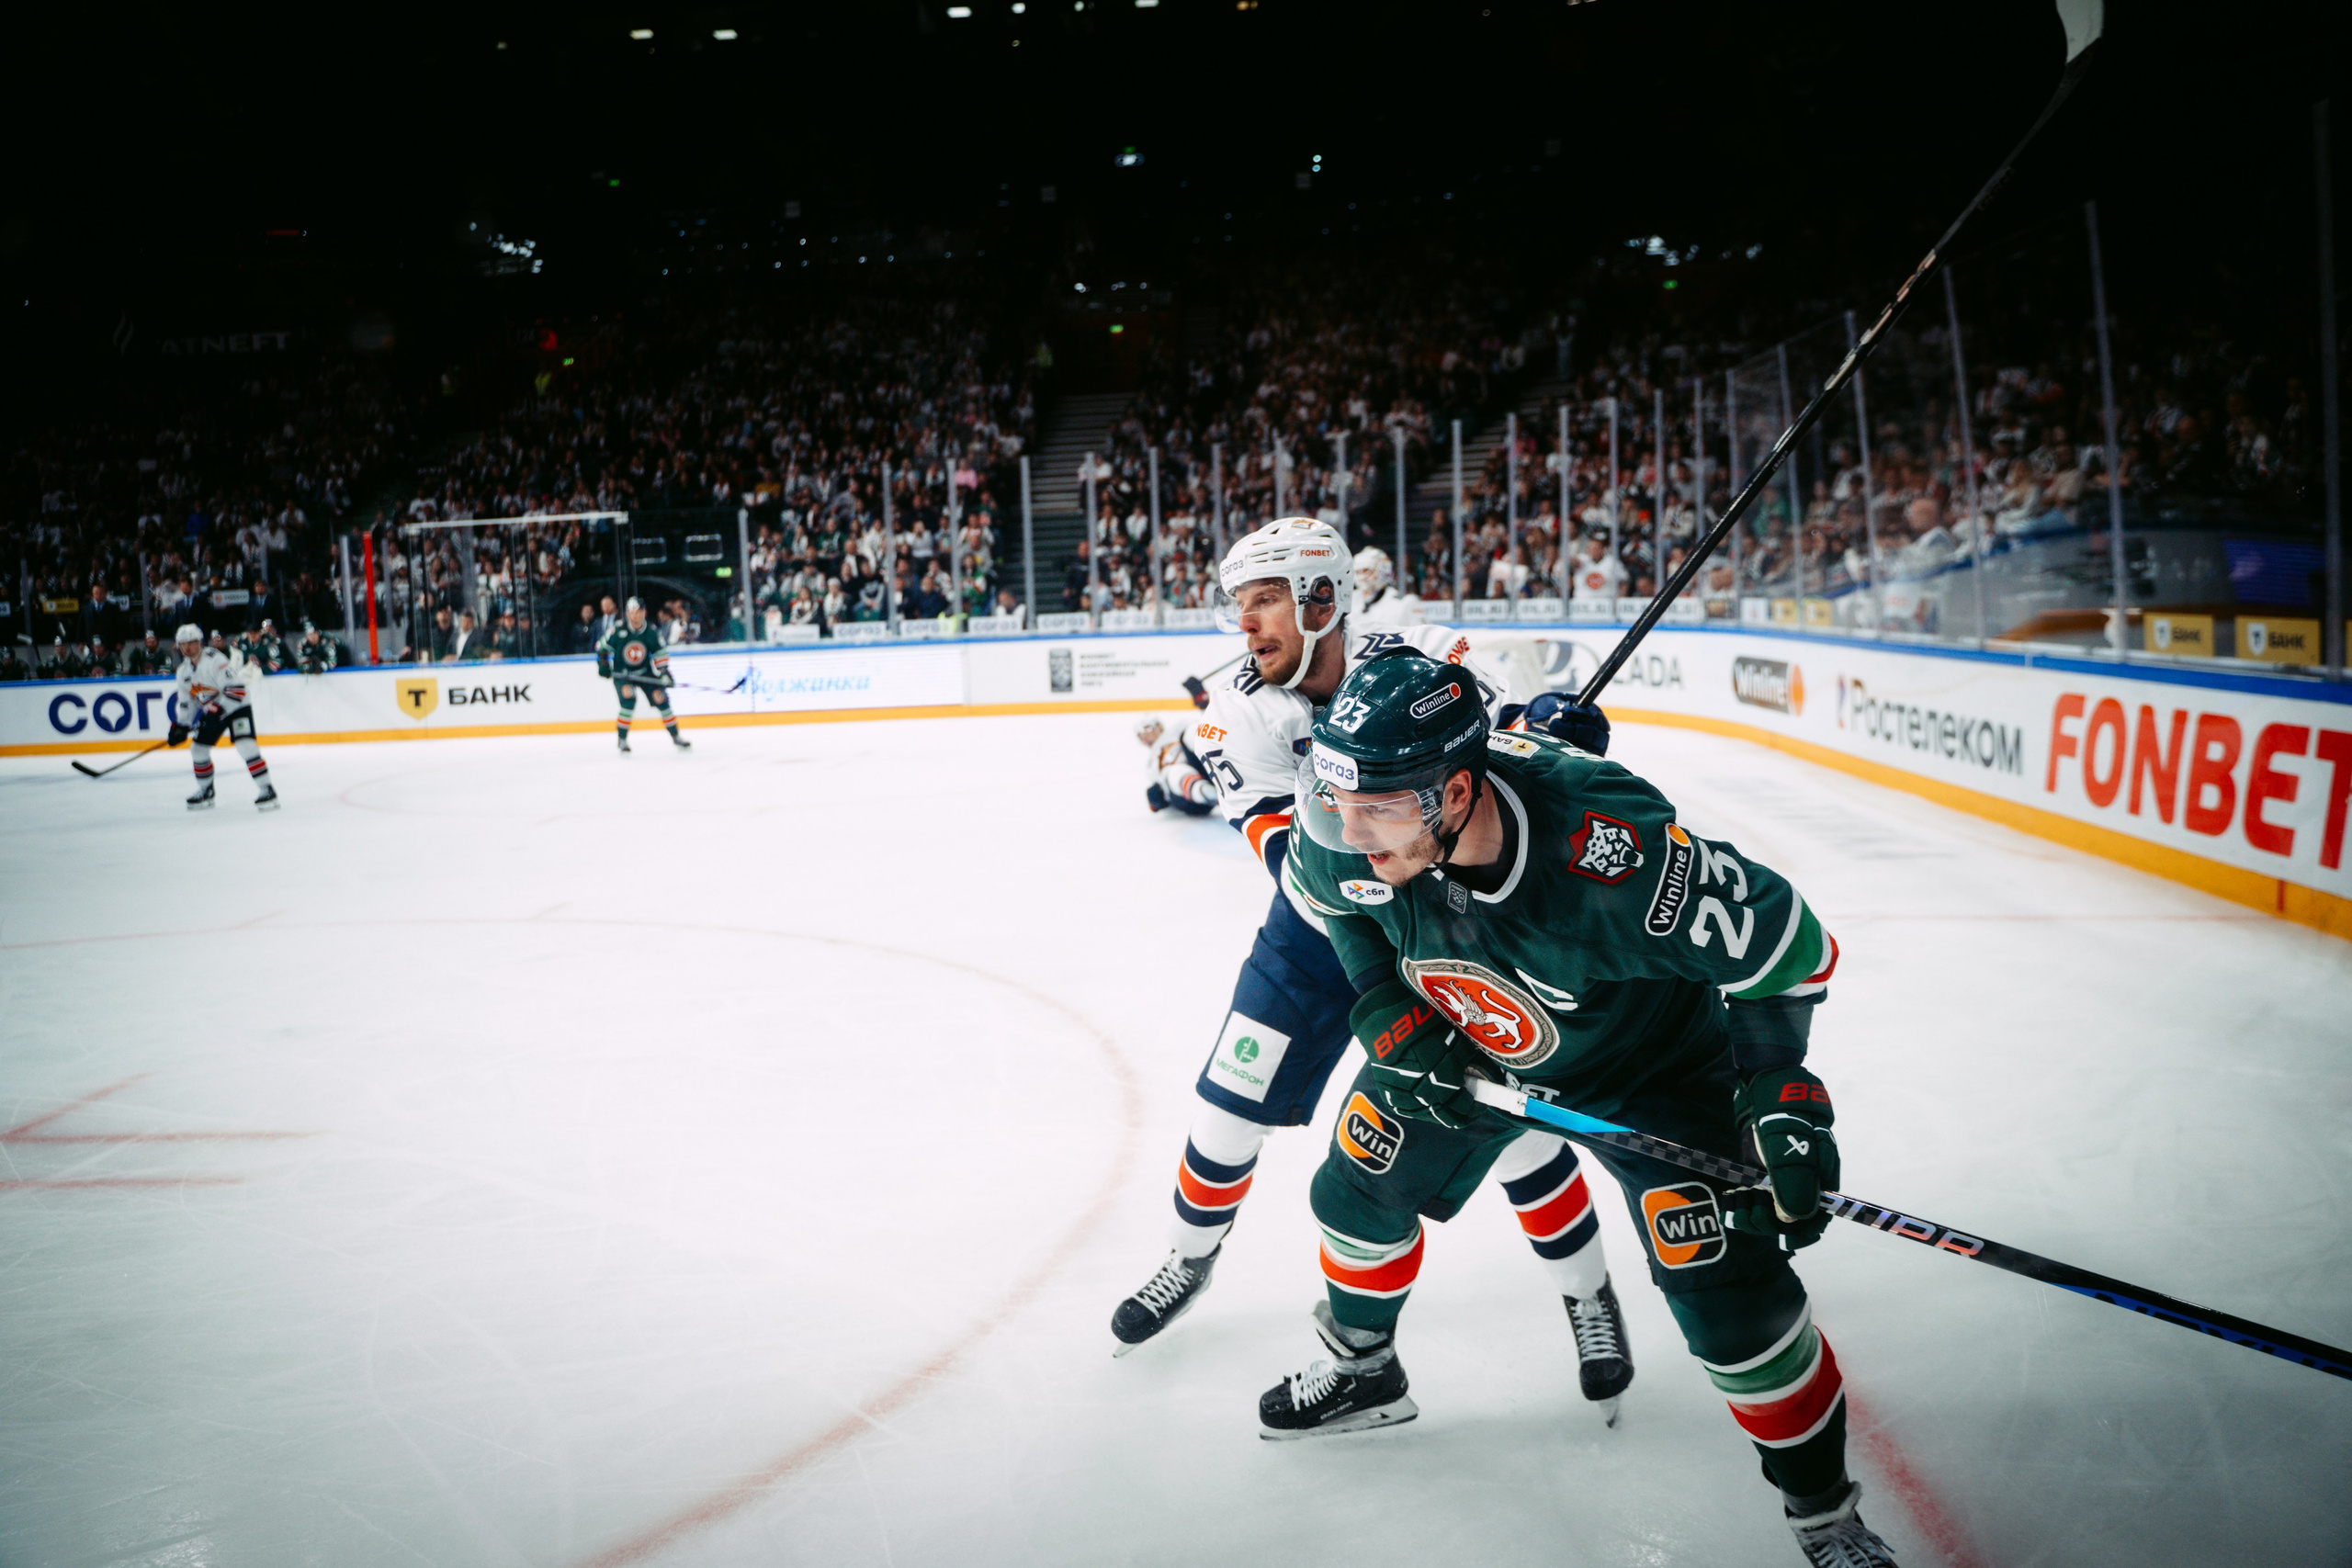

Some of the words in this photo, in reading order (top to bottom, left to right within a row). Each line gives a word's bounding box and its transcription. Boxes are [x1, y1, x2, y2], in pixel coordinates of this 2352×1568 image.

[156, 331, 292, 357] ATNEFT
[1300, 549, 1330, 558] FONBET
[448, 684, 532, 705] БАНК
[1734, 661, 1787, 706] Winline
[1329, 694, 1372, 732] 23
[1415, 692, 1451, 715] Winline
[1851, 678, 2024, 776] Ростелеком
[2044, 693, 2352, 870] FONBET
[1365, 886, 1385, 896] сбп
[1652, 849, 1688, 924] Winline
[1689, 839, 1754, 960] 23
[1216, 1056, 1265, 1087] МЕГАФОН
[1350, 1114, 1394, 1160] Win
[1659, 1209, 1718, 1242] Win
